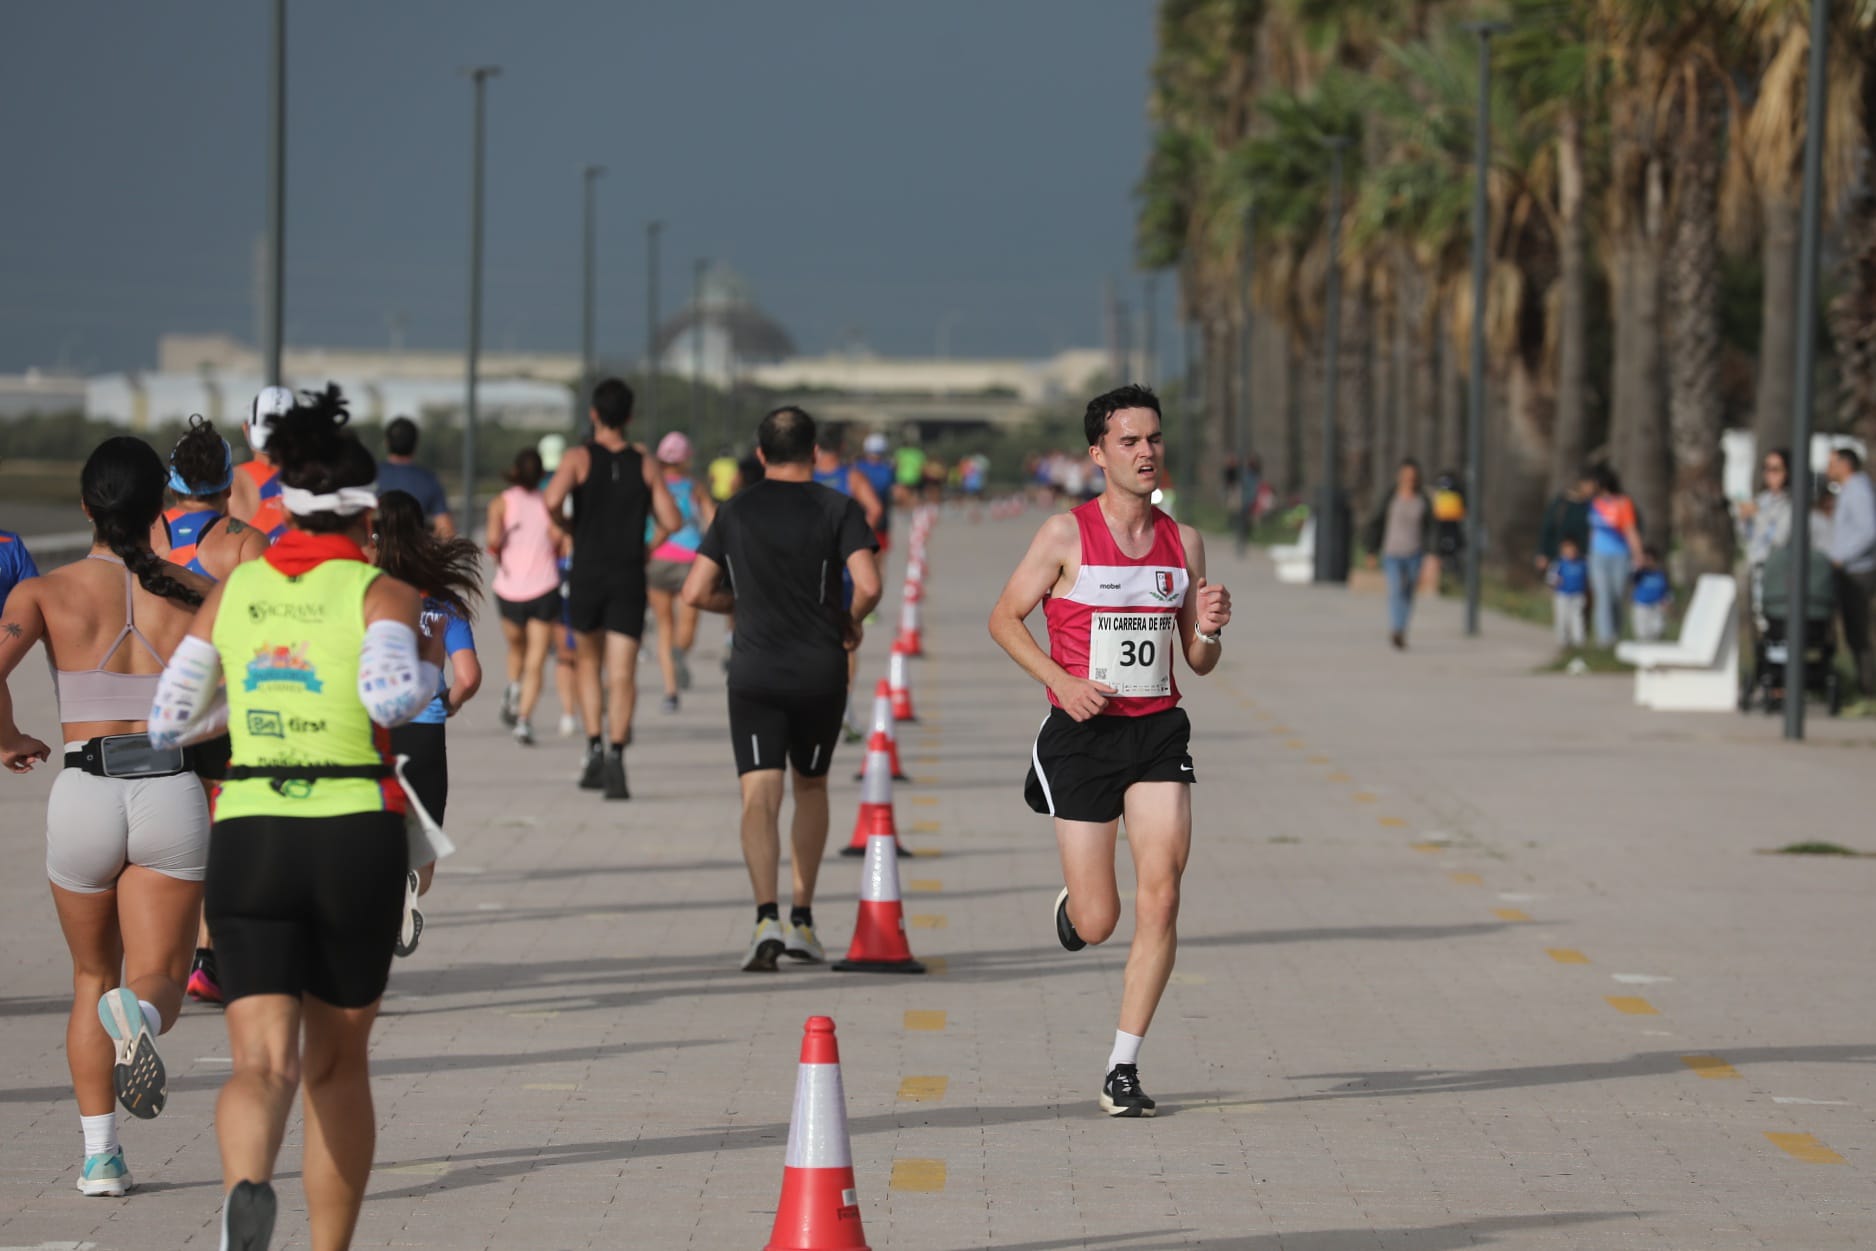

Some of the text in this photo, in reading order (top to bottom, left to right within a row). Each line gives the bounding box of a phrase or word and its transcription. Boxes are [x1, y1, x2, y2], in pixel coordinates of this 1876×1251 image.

[1098, 616, 1171, 631] XVI CARRERA DE PEPE
[1119, 640, 1155, 667] 30
[288, 716, 327, 733] first
